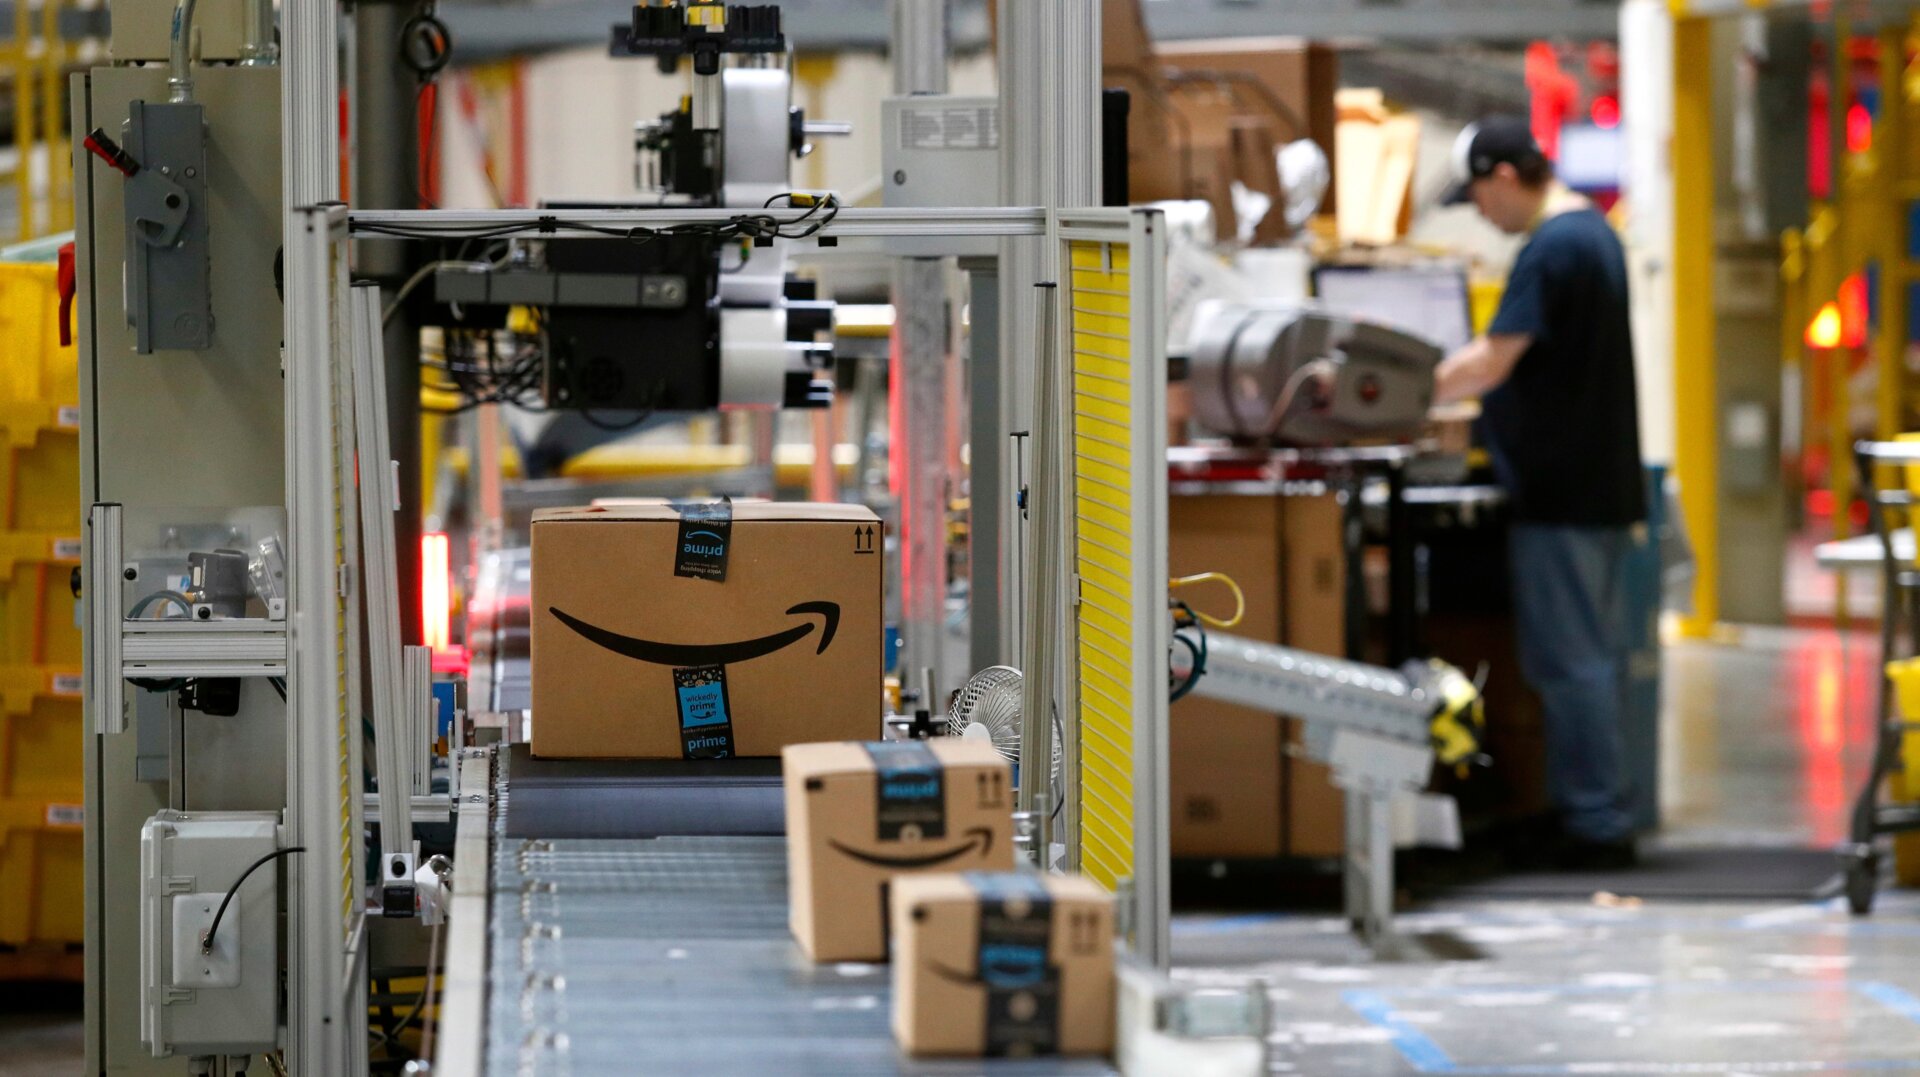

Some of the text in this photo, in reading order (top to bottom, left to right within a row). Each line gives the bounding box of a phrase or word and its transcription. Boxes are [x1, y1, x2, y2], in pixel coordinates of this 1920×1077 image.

[683, 543, 724, 558] prime
[686, 692, 718, 702] wickedly
[690, 701, 716, 713] prime
[687, 735, 727, 752] prime
